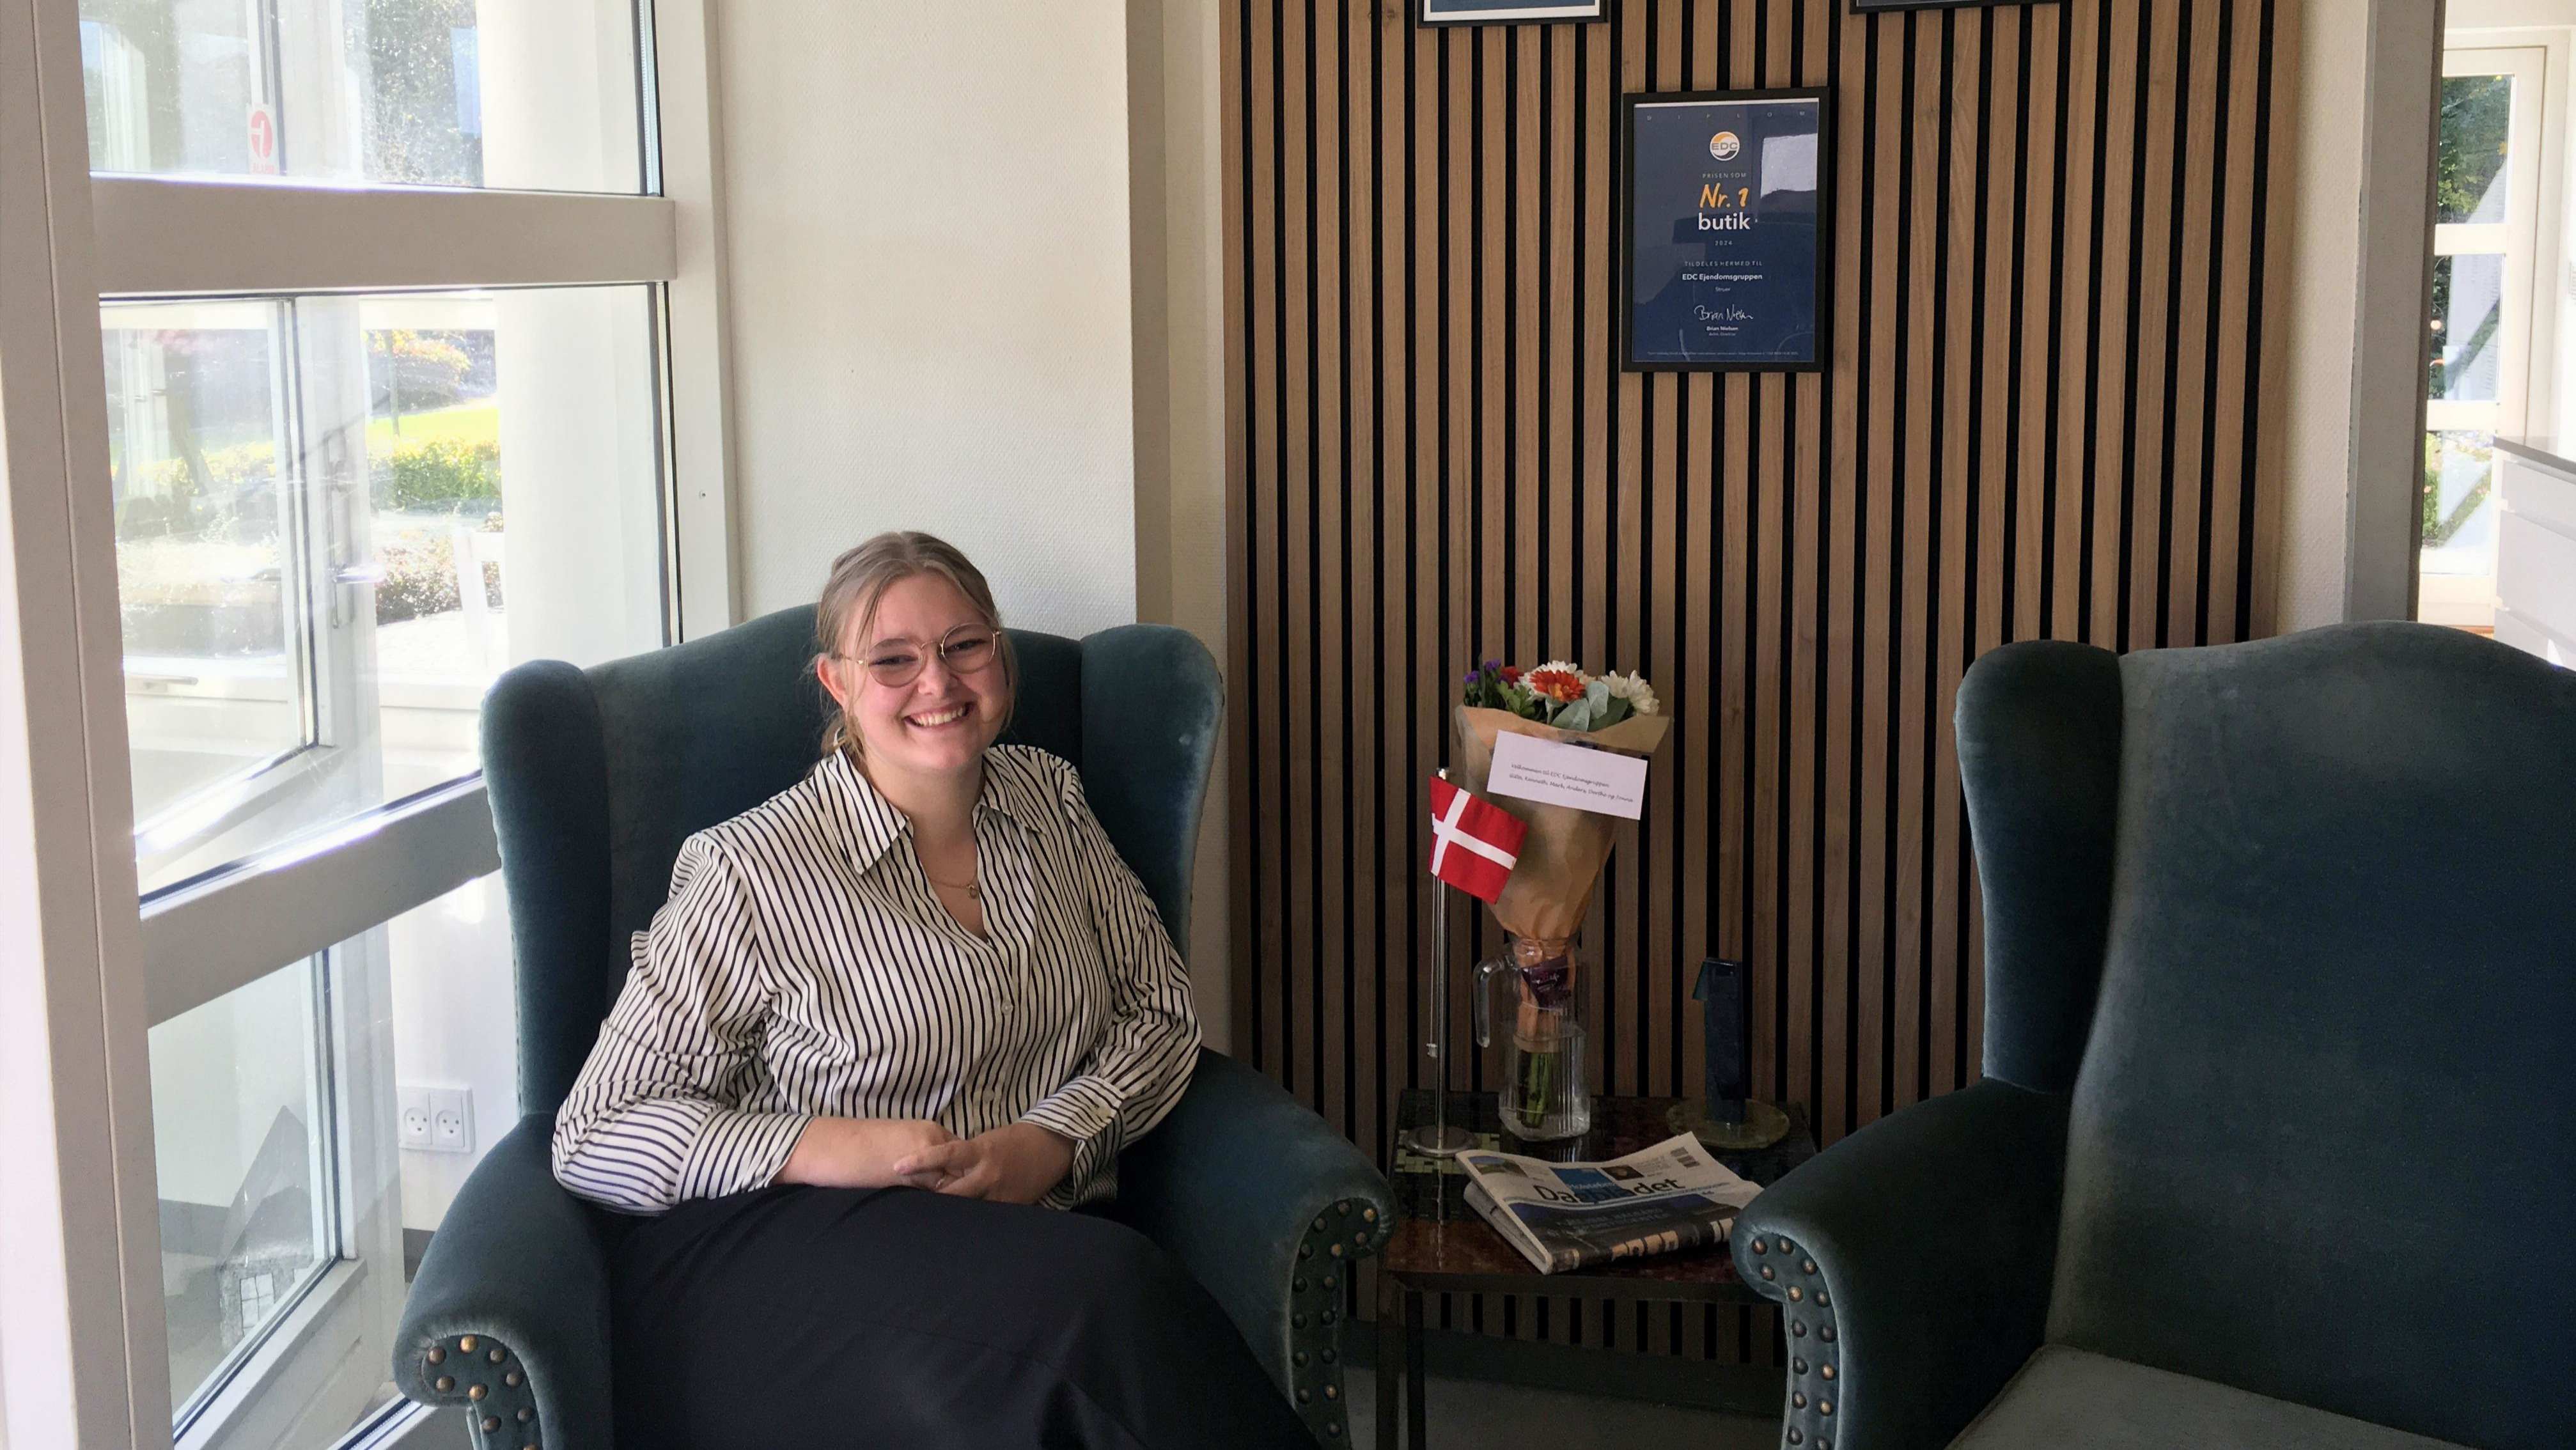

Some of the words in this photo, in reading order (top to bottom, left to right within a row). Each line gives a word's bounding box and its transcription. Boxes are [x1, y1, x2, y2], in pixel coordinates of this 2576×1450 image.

[1711, 142, 1738, 151] EDC
[1699, 182, 1730, 208] Nr.
[1738, 187, 1749, 207] 1
[1698, 212, 1751, 230] butik
[1699, 273, 1763, 281] Ejendomsgruppen
